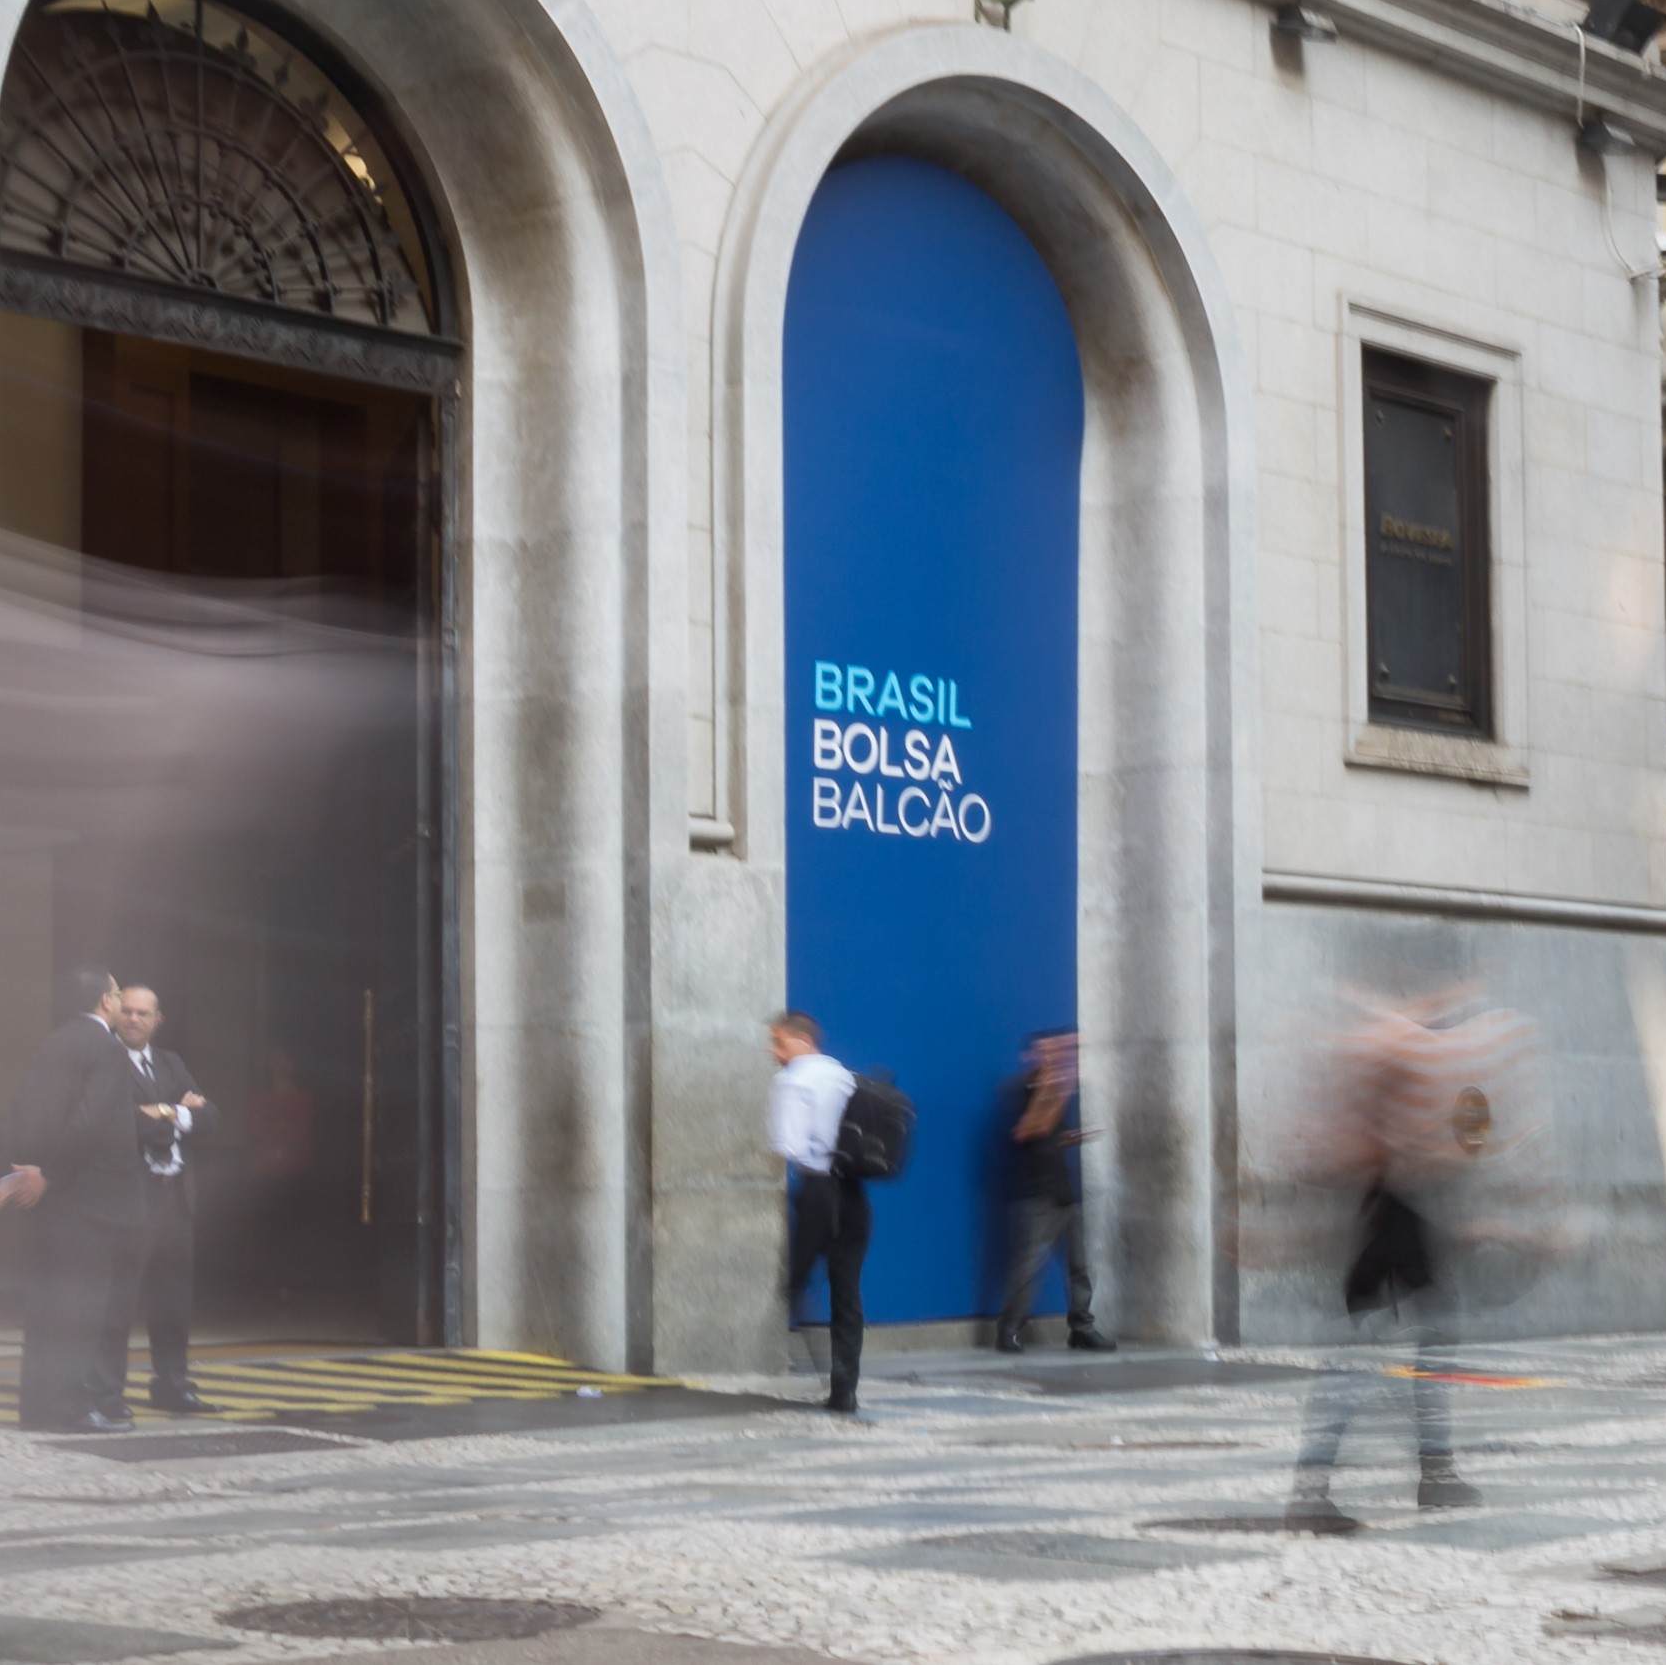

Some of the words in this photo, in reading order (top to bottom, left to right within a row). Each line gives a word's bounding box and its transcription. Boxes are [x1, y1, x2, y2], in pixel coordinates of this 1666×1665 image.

[814, 659, 973, 730] BRASIL
[813, 717, 963, 785] BOLSA
[813, 776, 992, 844] BALCÃO
